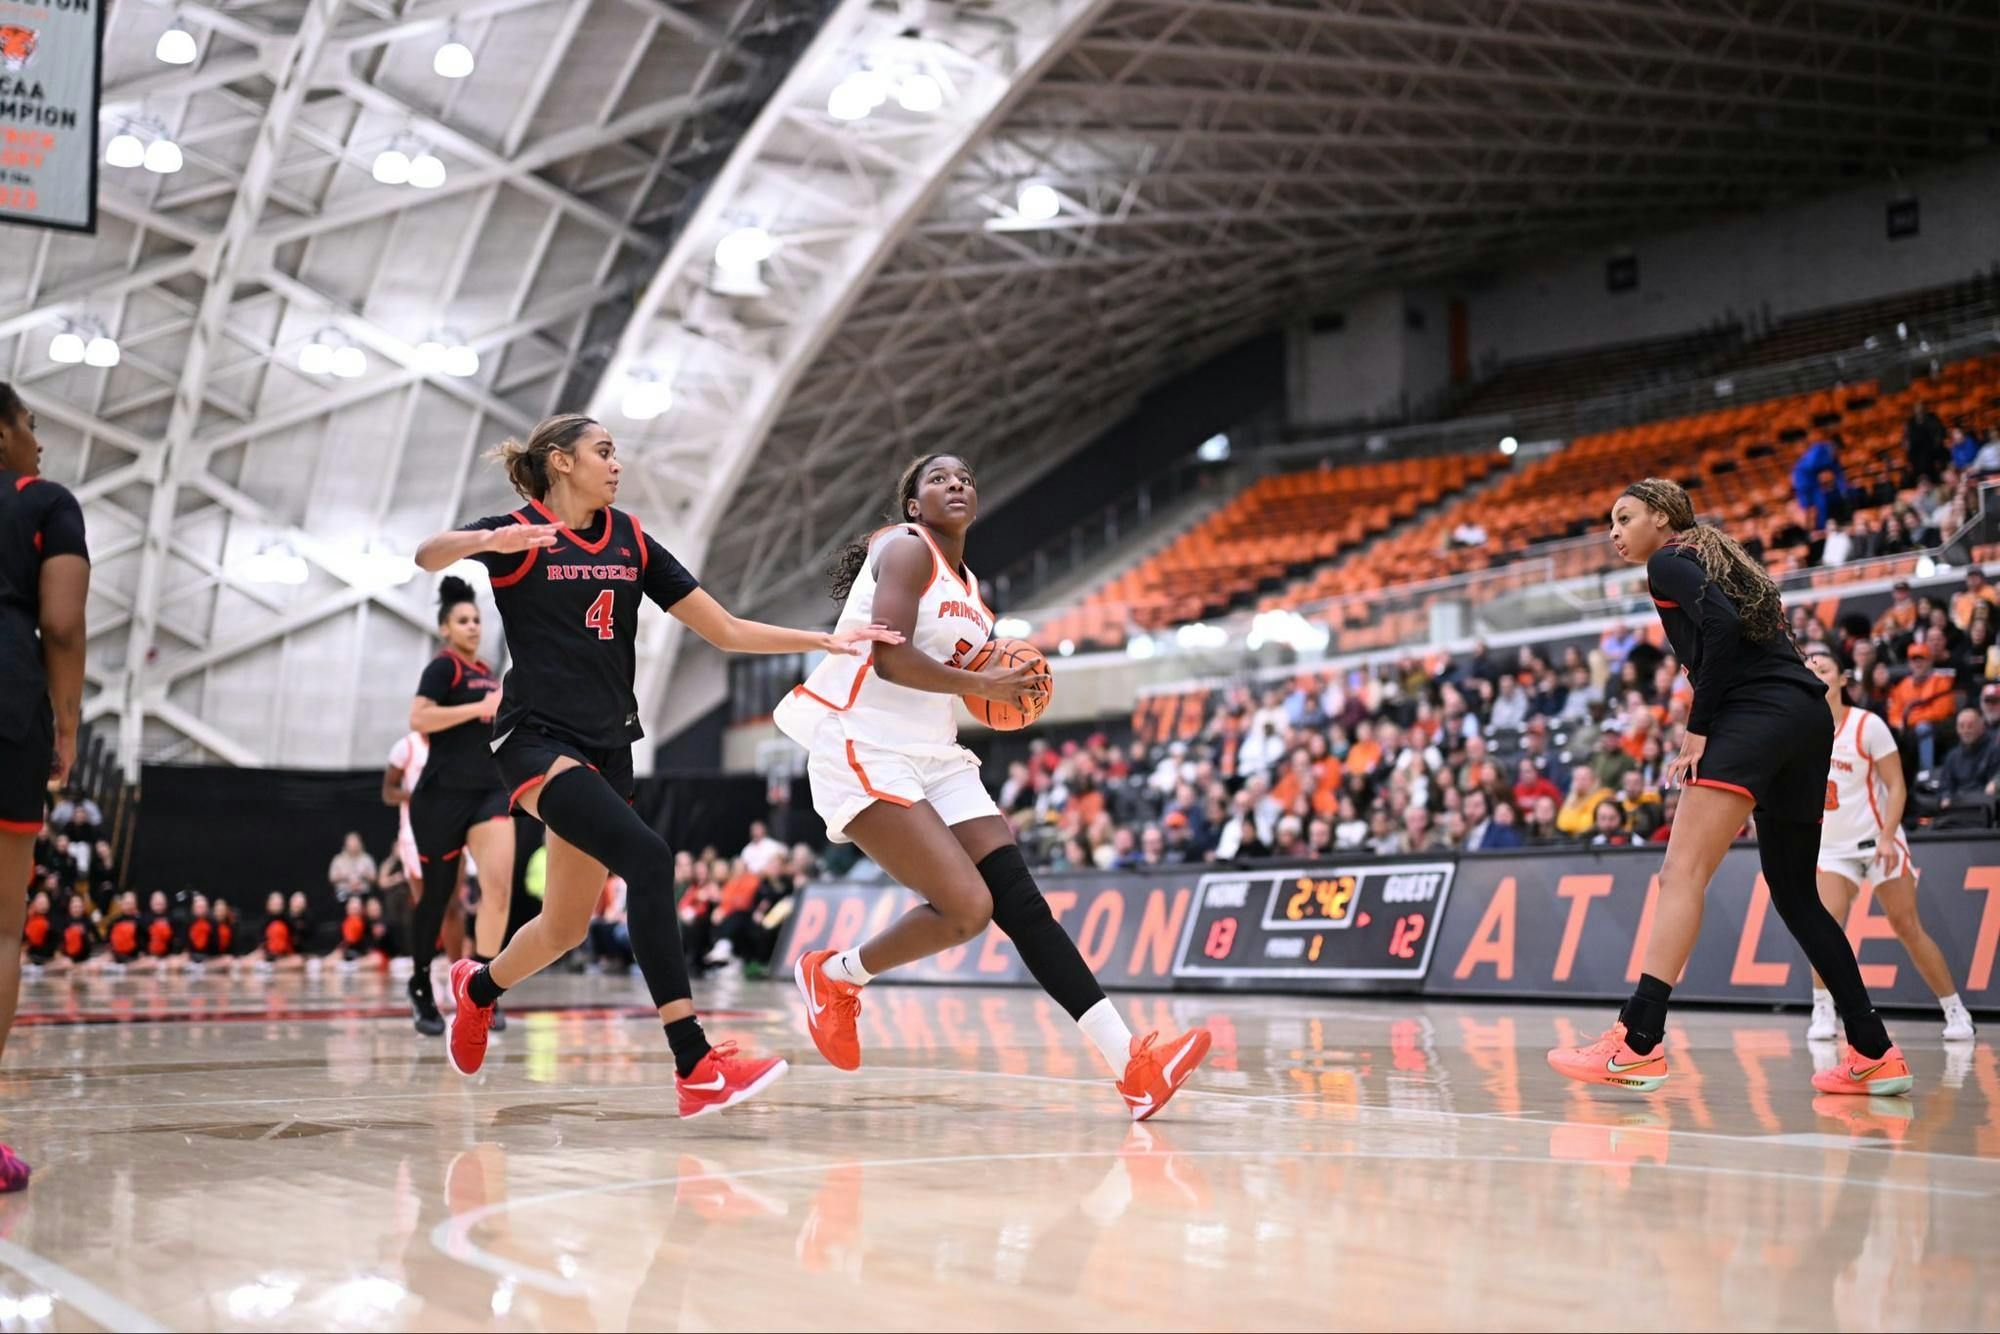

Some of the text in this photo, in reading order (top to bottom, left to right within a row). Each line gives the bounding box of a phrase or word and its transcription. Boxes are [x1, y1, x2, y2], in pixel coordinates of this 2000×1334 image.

[547, 564, 639, 581] RUTGERS
[585, 589, 614, 639] 4
[1382, 873, 1441, 903] GUEST
[1388, 913, 1425, 958] 12
